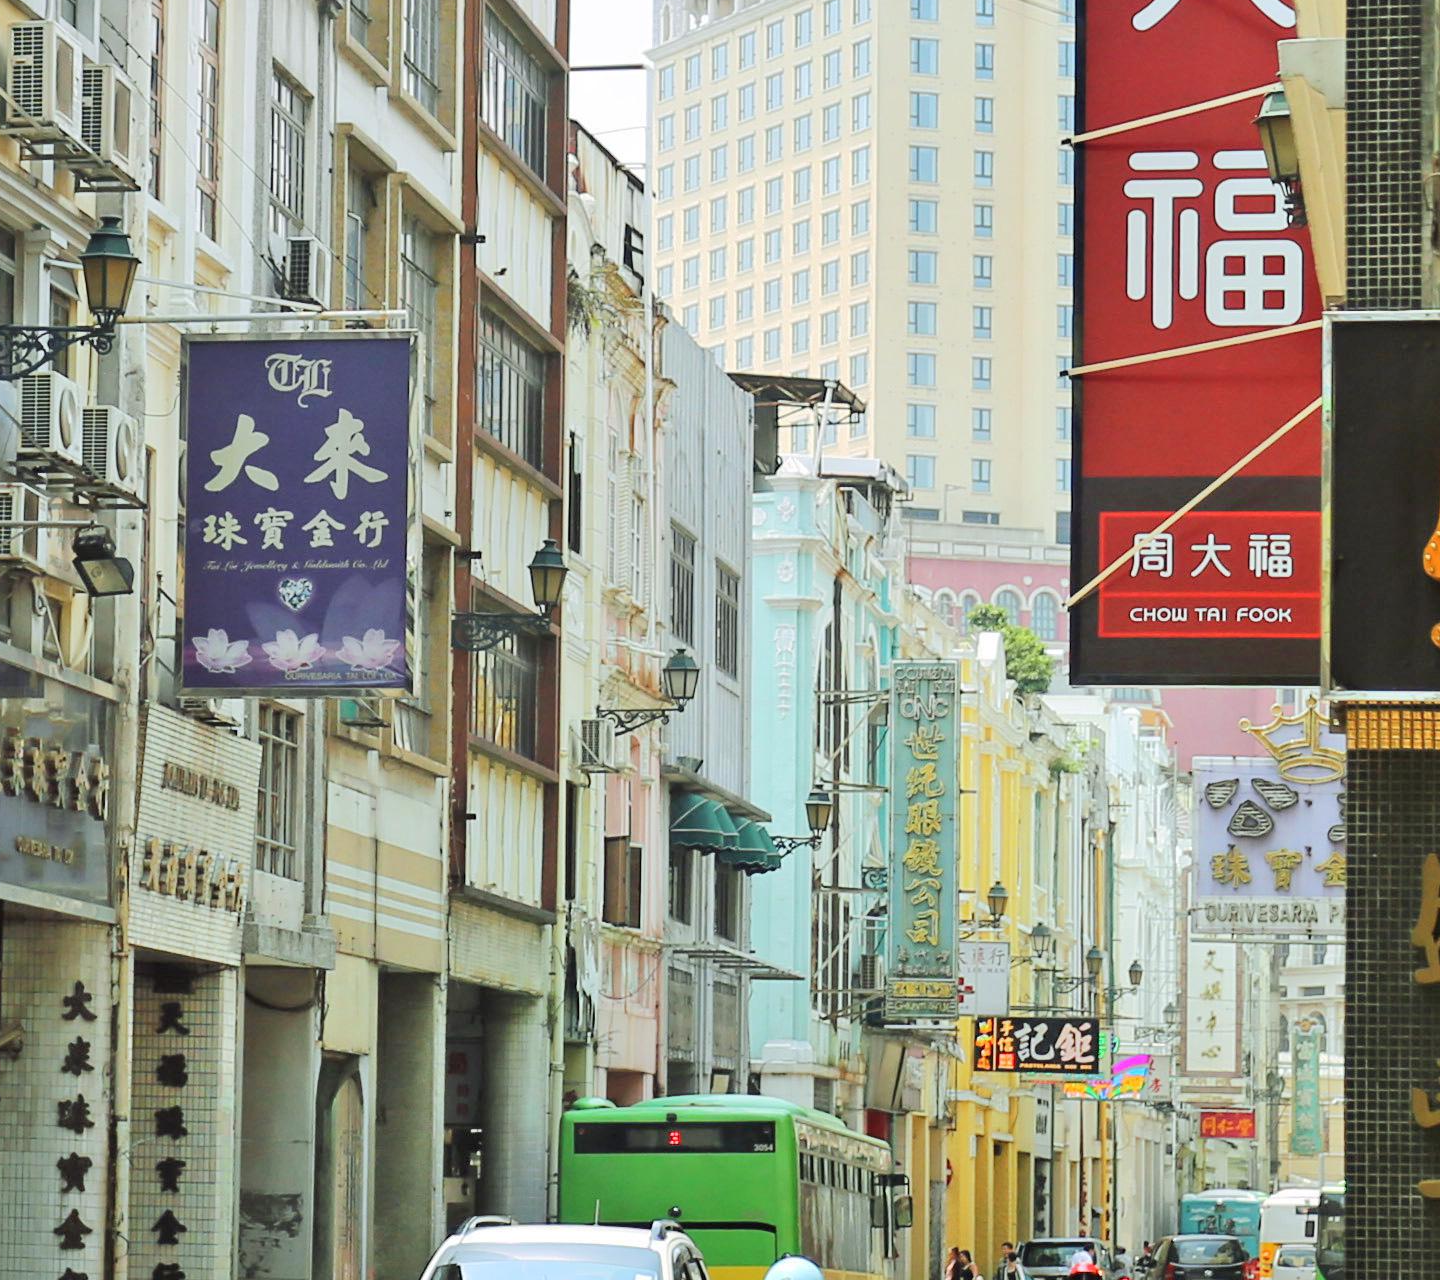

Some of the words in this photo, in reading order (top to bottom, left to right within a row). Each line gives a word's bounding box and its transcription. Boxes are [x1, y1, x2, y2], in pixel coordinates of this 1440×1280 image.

[204, 407, 389, 500] 大來
[202, 506, 389, 551] 珠寶金行
[1130, 532, 1293, 579] 周大福
[1129, 607, 1188, 624] CHOW
[1193, 607, 1228, 623] TAI
[1235, 606, 1293, 623] FOOK
[1206, 903, 1318, 923] OURIVESARIA
